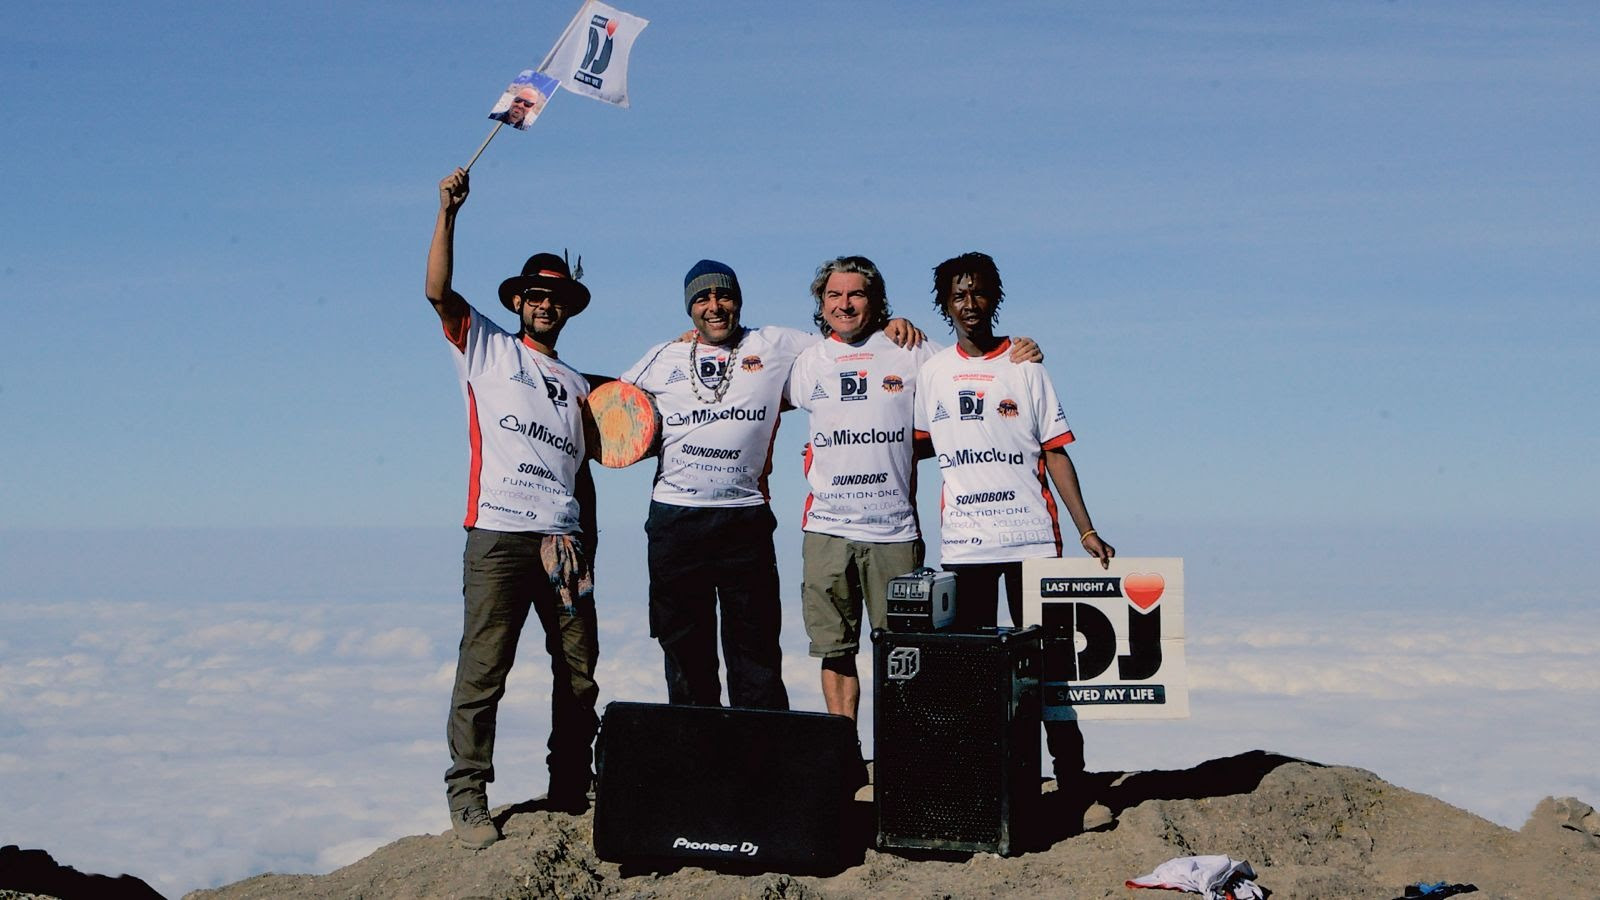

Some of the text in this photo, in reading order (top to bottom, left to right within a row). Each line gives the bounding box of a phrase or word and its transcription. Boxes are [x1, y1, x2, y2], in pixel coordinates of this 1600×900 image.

[841, 377, 867, 396] DJ
[959, 396, 984, 415] DJ
[692, 405, 766, 425] Mixcloud
[833, 427, 905, 447] Mixcloud
[681, 443, 742, 460] SOUNDBOKS
[831, 472, 888, 486] SOUNDBOKS
[819, 488, 900, 500] FUNKTION-ONE
[955, 490, 1016, 506] SOUNDBOKS
[480, 501, 522, 516] Pioneer
[1046, 582, 1115, 592] LAST NIGHT A
[1041, 602, 1163, 681] DJ
[1104, 689, 1126, 701] MY
[1130, 689, 1154, 700] LIFE
[672, 837, 738, 852] Pioneer
